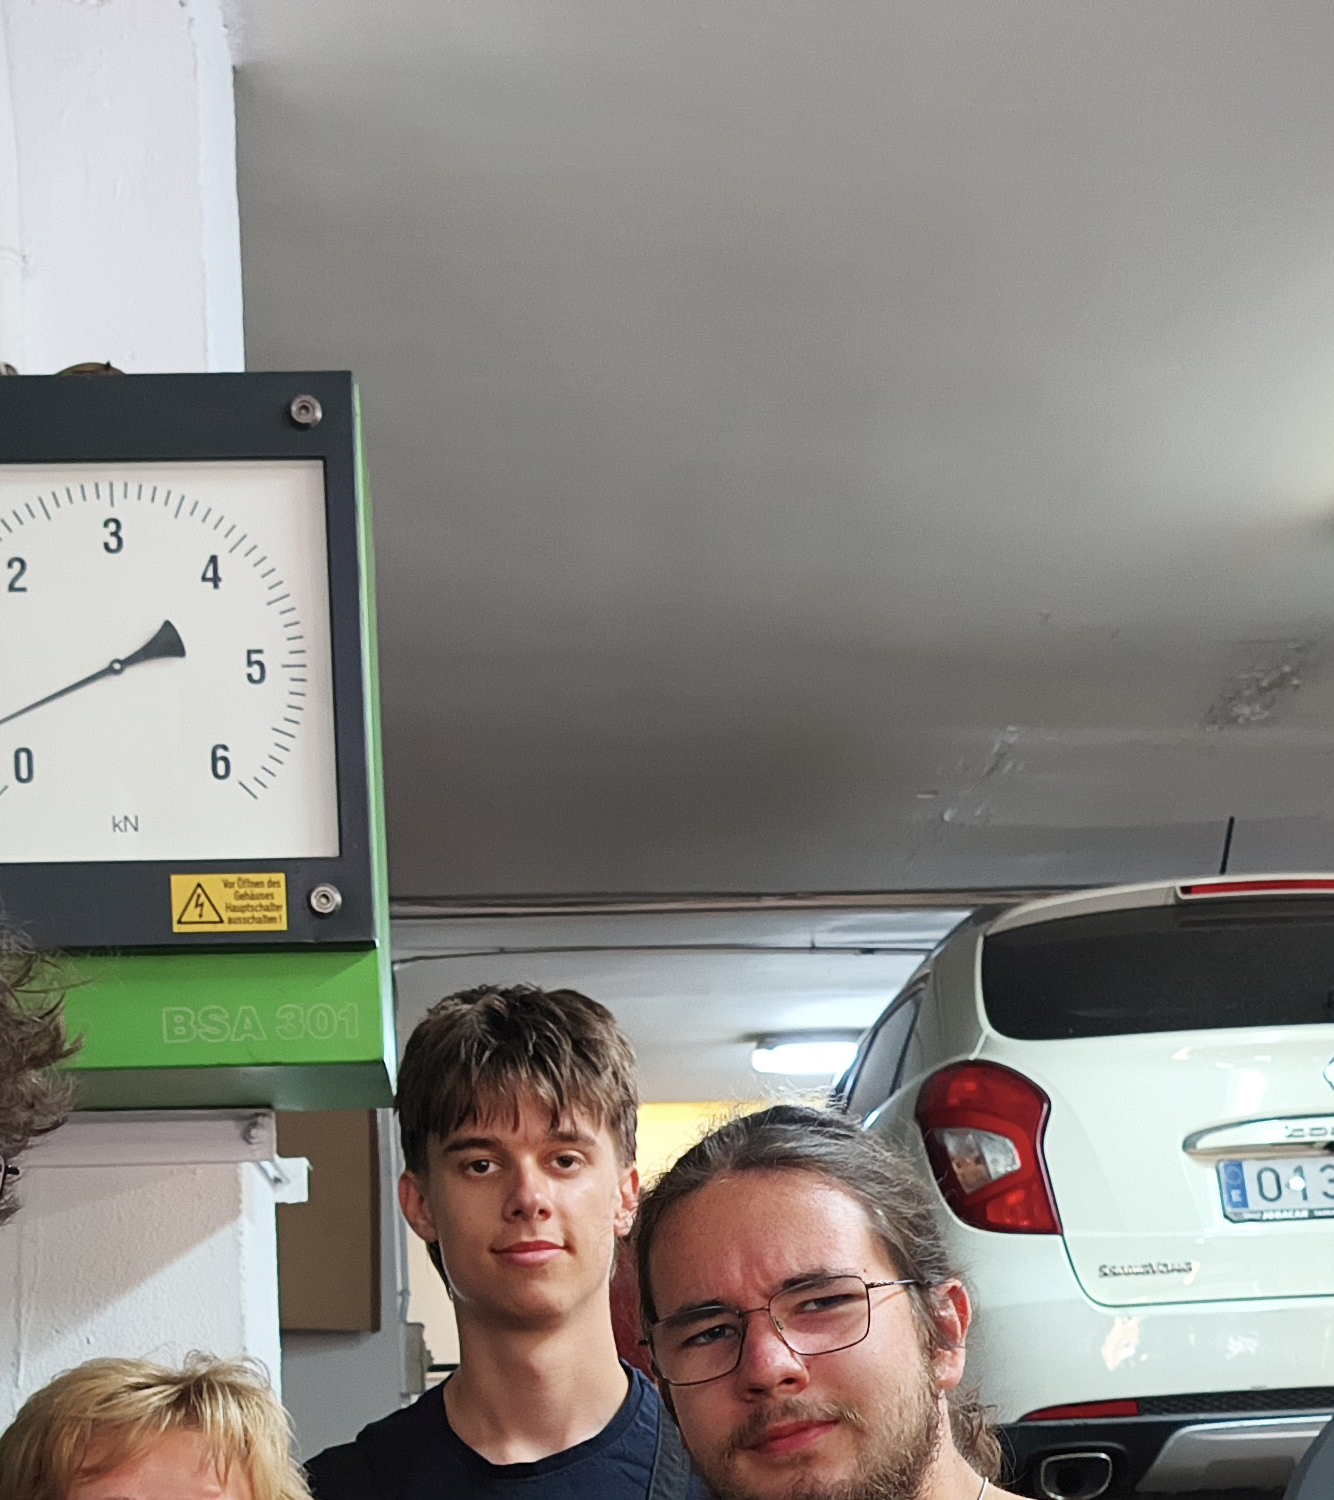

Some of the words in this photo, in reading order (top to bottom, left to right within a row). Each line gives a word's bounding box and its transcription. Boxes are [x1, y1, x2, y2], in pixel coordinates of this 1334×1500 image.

[103, 517, 123, 554] 3
[7, 556, 27, 593] 2
[201, 554, 222, 589] 4
[246, 649, 266, 685] 5
[14, 747, 34, 784] 0
[211, 744, 231, 780] 6
[111, 814, 139, 833] kN
[162, 1005, 267, 1043] BSA
[276, 1003, 359, 1040] 301
